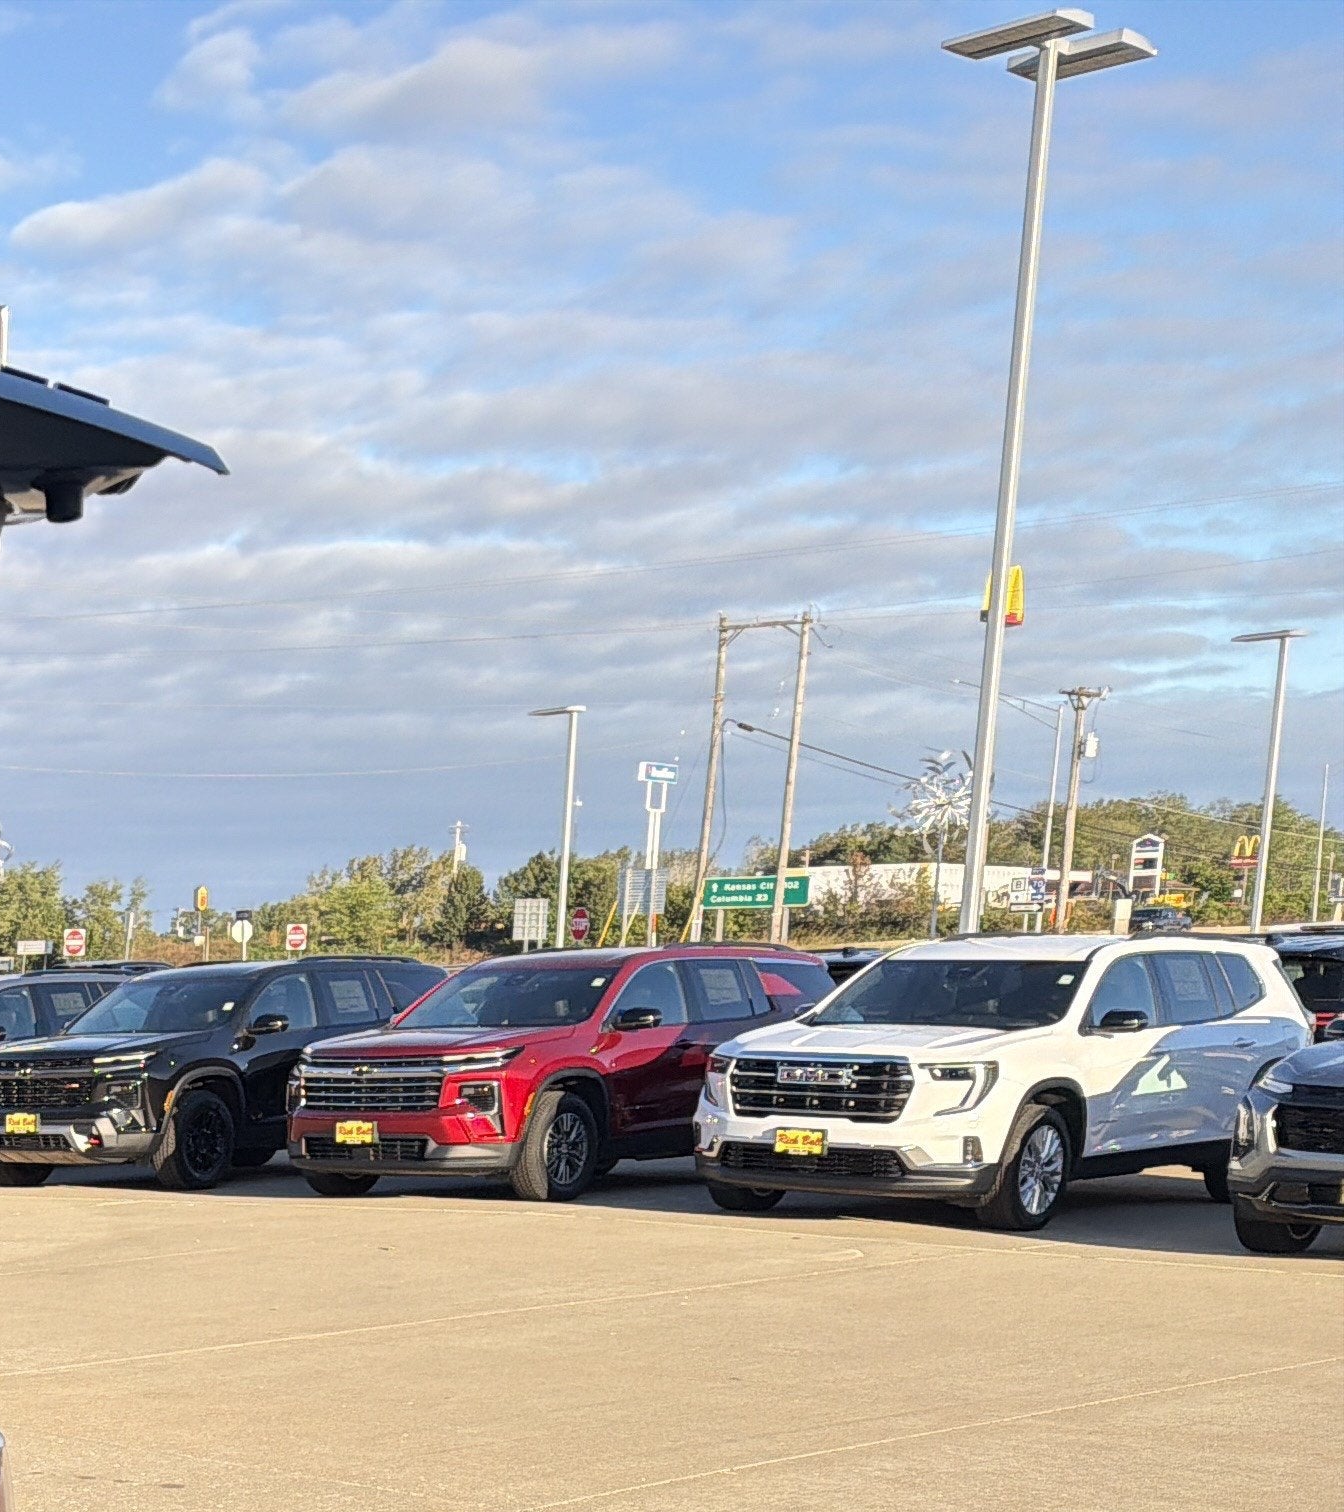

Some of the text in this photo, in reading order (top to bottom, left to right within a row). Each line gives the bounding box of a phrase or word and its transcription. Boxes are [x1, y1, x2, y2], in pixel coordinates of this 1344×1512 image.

[723, 883, 757, 891] Kansas
[759, 881, 775, 890] Cit
[709, 895, 753, 903] Columbia
